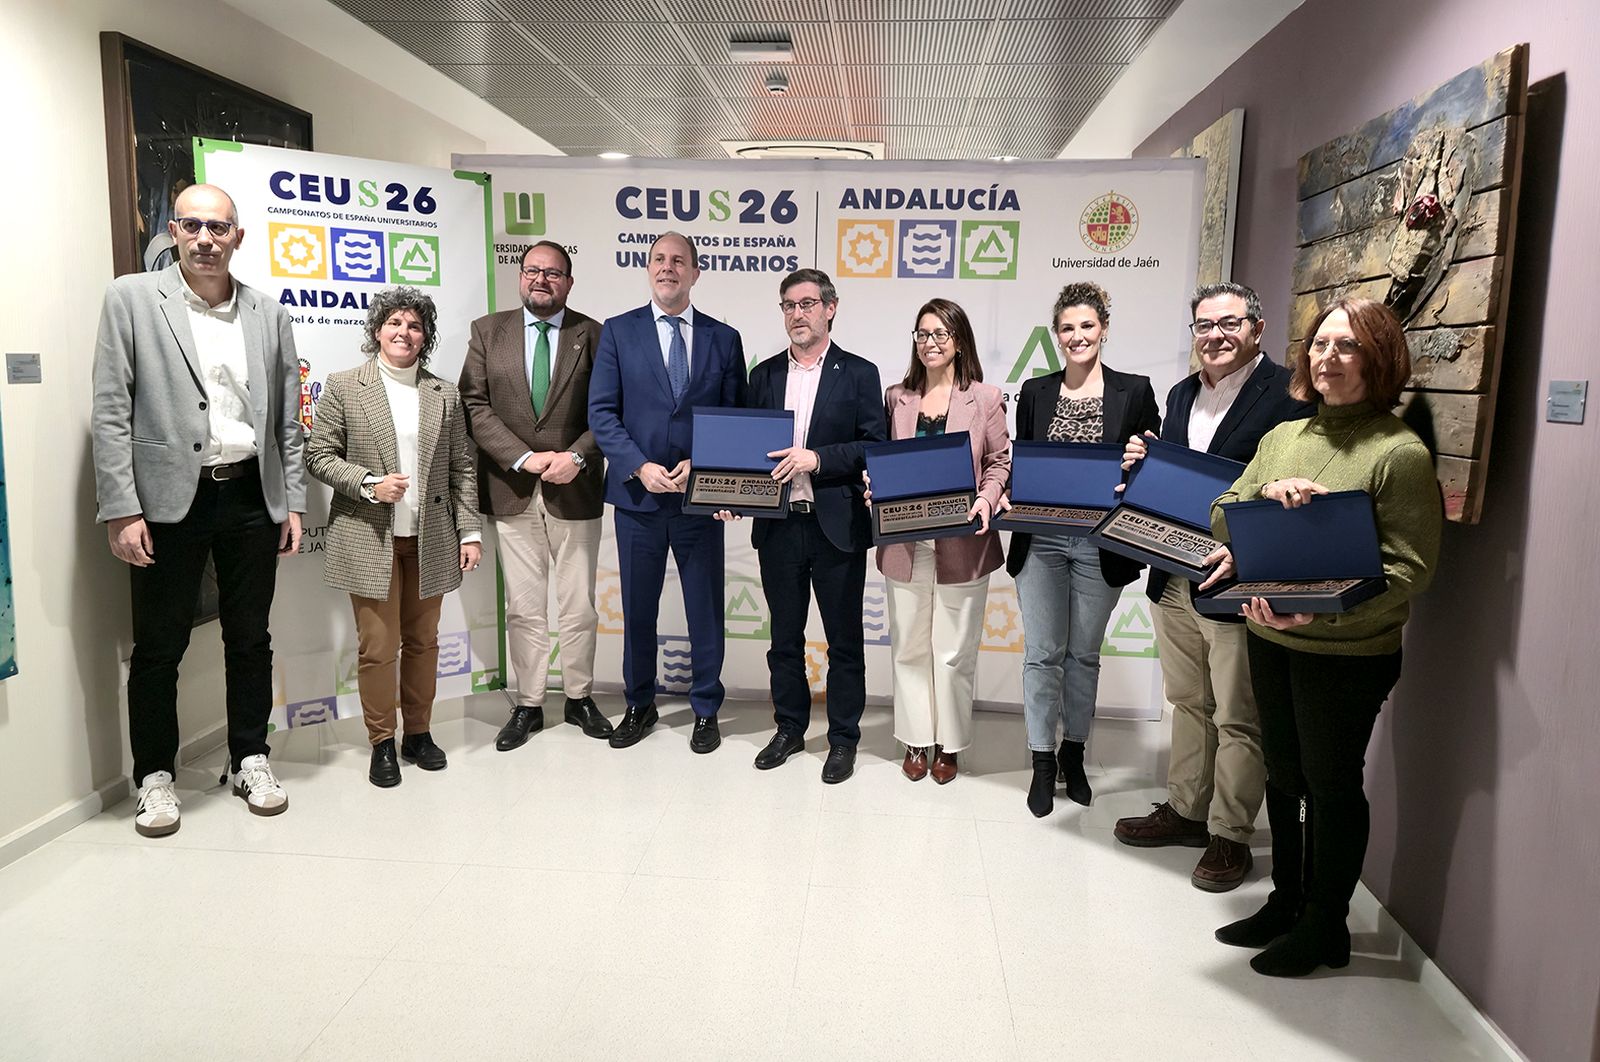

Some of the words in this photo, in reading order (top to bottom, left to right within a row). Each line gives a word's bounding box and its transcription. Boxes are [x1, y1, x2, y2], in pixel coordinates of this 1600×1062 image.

[838, 183, 1021, 211] ANDALUCÍA
[267, 206, 331, 219] CAMPEONATOS
[332, 212, 344, 221] DE
[345, 213, 376, 223] ESPAÑA
[377, 216, 438, 229] UNIVERSITARIOS
[617, 233, 720, 247] CAMPTOS
[723, 236, 740, 247] DE
[743, 234, 796, 248] ESPAÑA
[498, 255, 508, 264] DE
[615, 251, 799, 273] UNSITARIOS
[1052, 257, 1116, 268] Universidad
[1118, 257, 1131, 268] de
[1133, 256, 1160, 268] Jaén
[279, 288, 370, 310] ANDAL
[307, 315, 315, 324] 6
[317, 315, 331, 325] de
[333, 318, 365, 326] marzo
